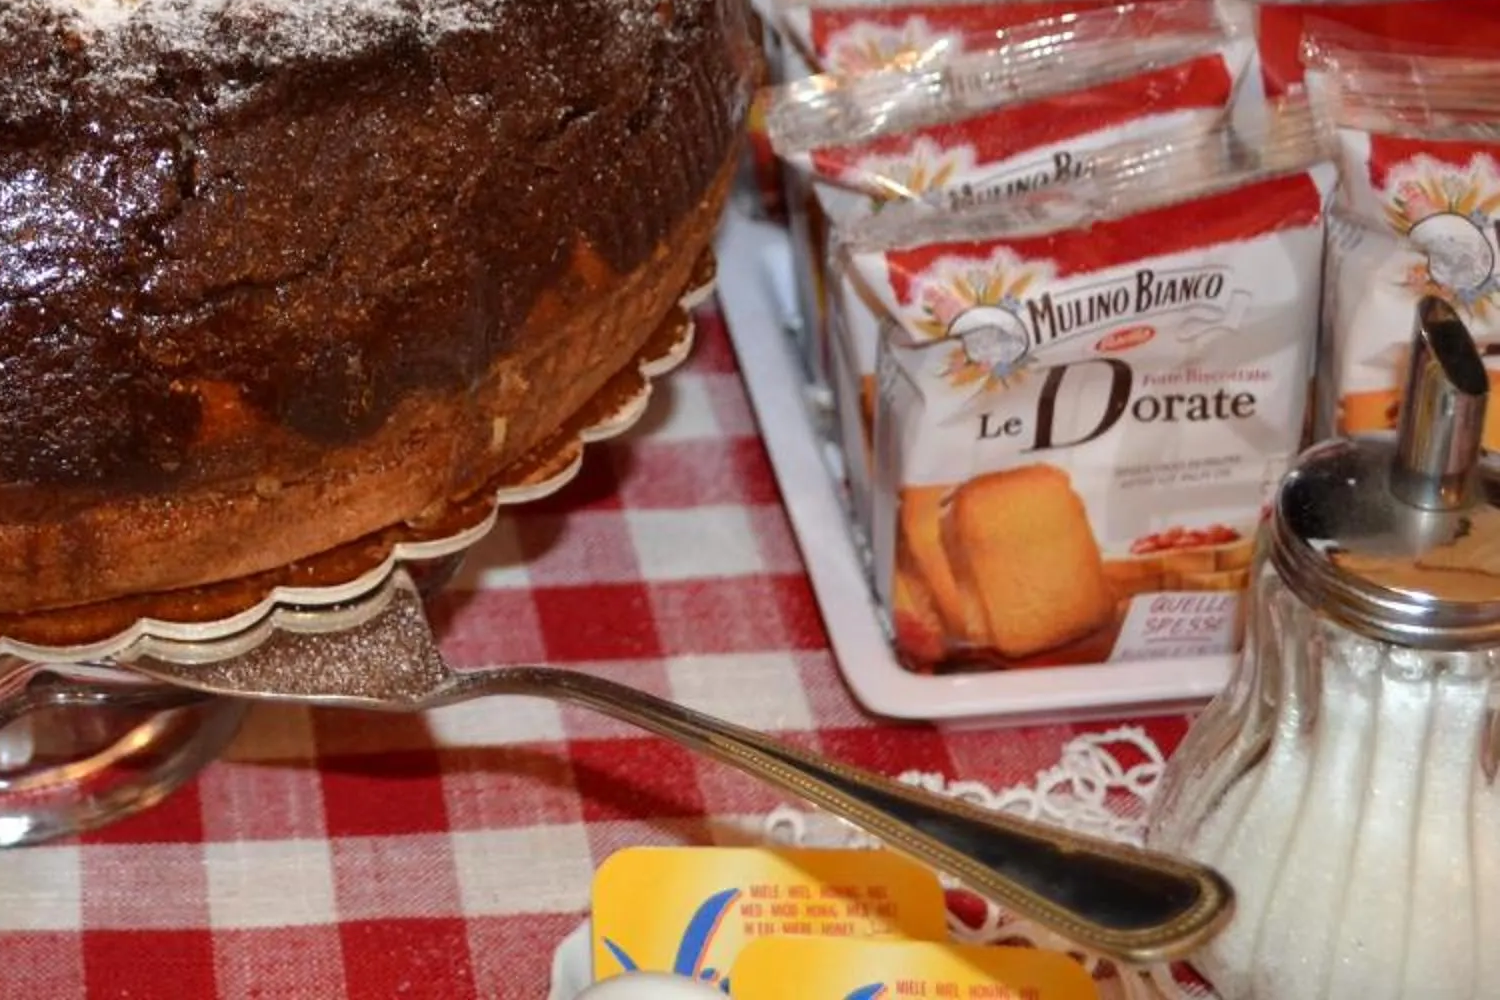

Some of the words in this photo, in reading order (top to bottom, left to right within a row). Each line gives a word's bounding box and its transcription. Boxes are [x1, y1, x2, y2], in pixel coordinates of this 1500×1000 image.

[948, 174, 1048, 209] MULINO
[1053, 150, 1098, 182] BIA
[1027, 288, 1130, 346] MULINO
[1135, 268, 1225, 315] BIANCO
[978, 414, 1023, 440] Le
[1019, 356, 1256, 454] Dorate
